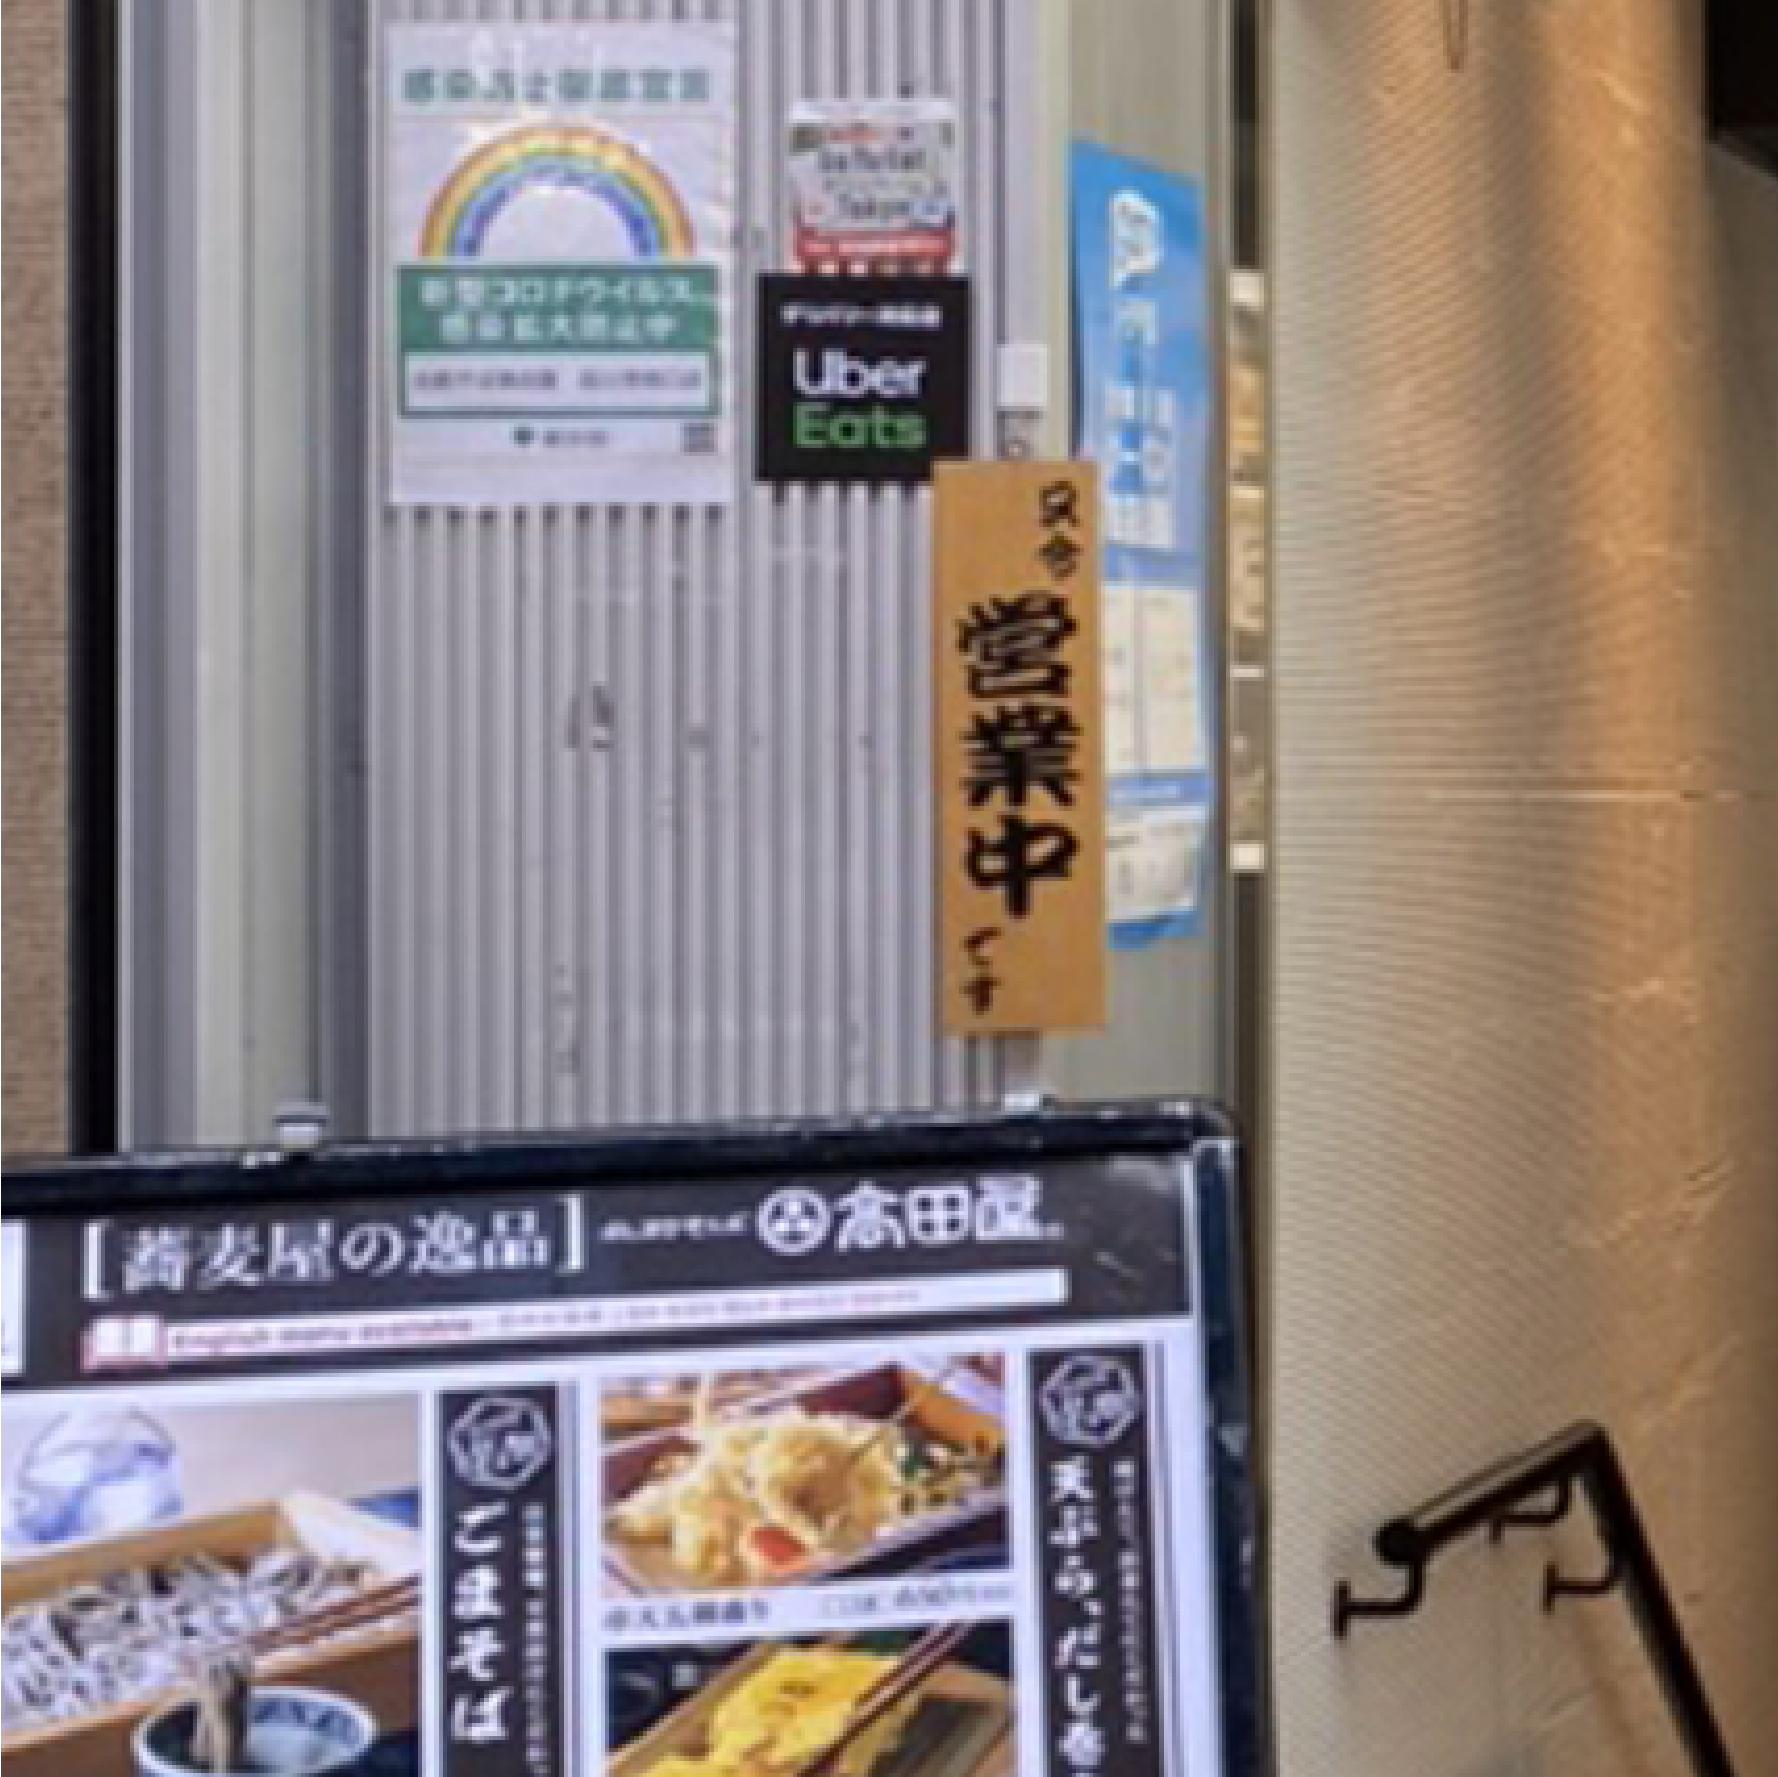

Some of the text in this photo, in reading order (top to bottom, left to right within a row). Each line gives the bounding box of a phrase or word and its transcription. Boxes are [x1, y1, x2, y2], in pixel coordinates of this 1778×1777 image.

[792, 348, 928, 399] Uber
[792, 401, 928, 449] Eats
[955, 588, 1080, 920] 営業中
[834, 1173, 1046, 1254] 高田屋
[448, 1498, 516, 1744] ごまそば
